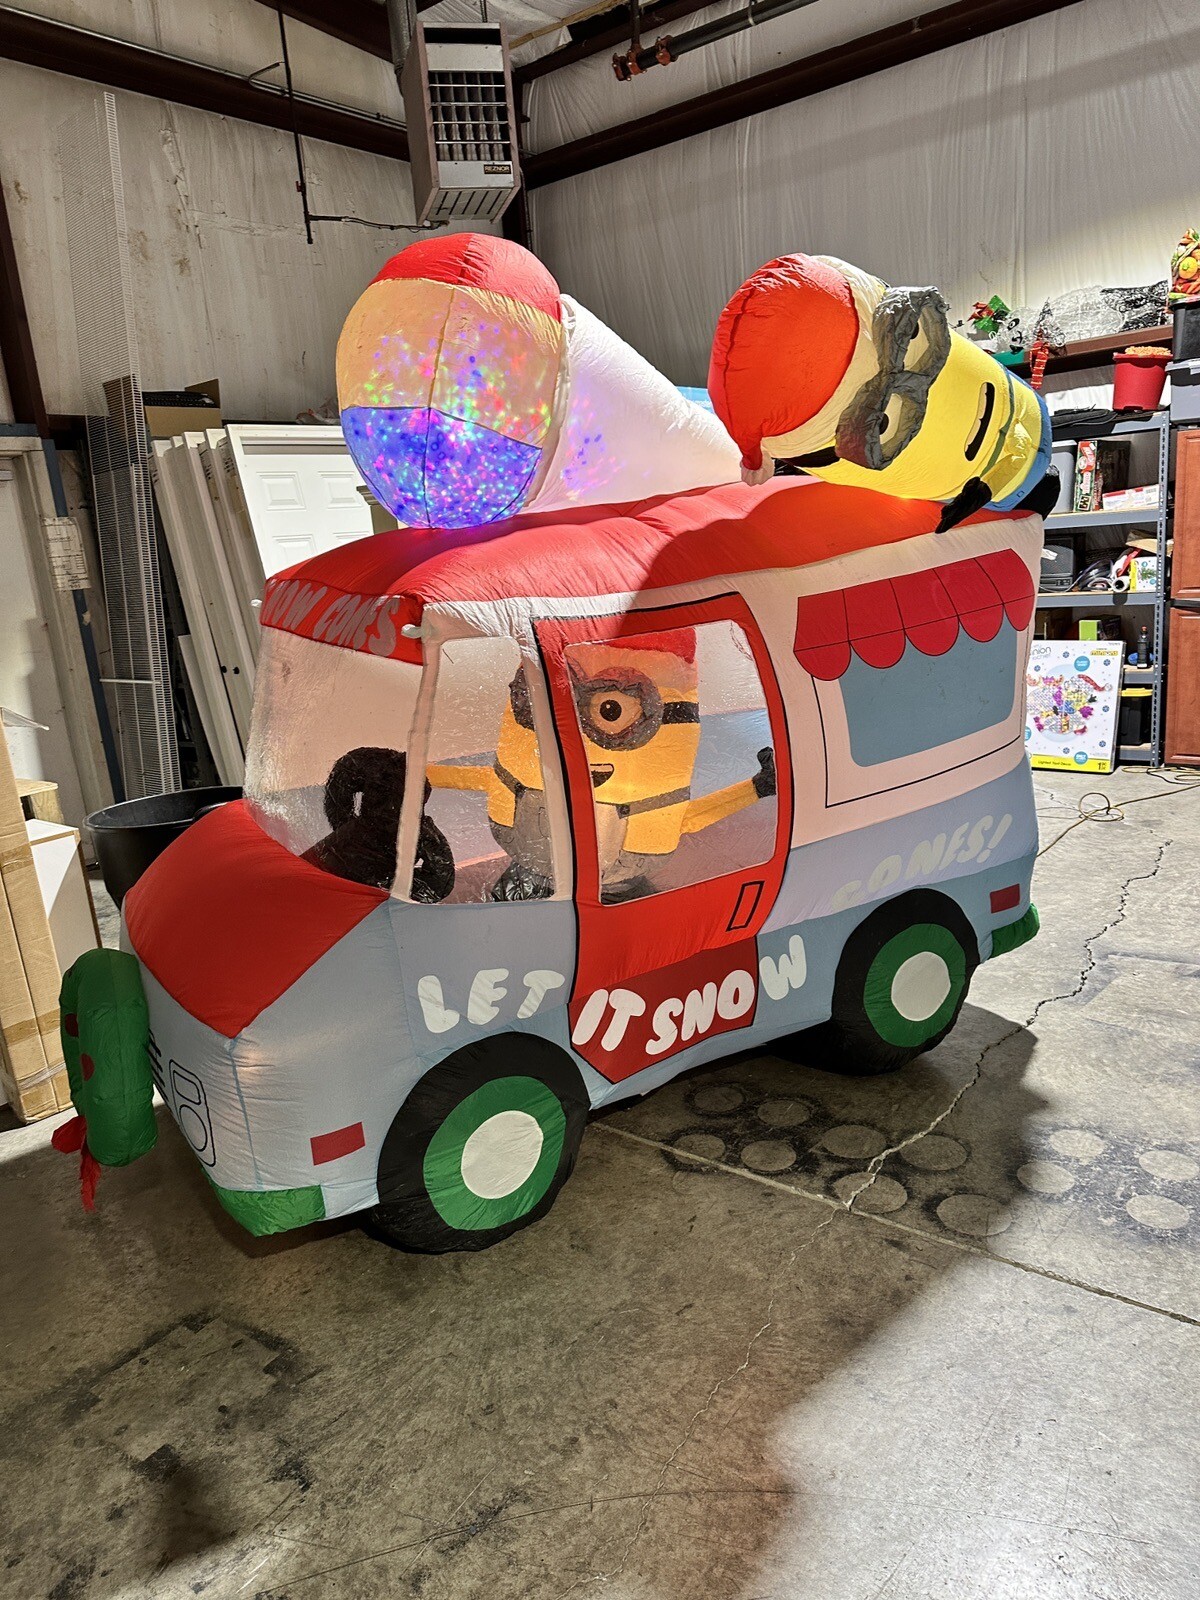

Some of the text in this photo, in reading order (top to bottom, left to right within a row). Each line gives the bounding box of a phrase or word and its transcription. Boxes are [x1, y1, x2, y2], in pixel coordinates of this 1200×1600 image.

[312, 594, 402, 657] CONES
[831, 813, 1013, 912] CONES!
[417, 934, 808, 1056] LET IT SNOW
